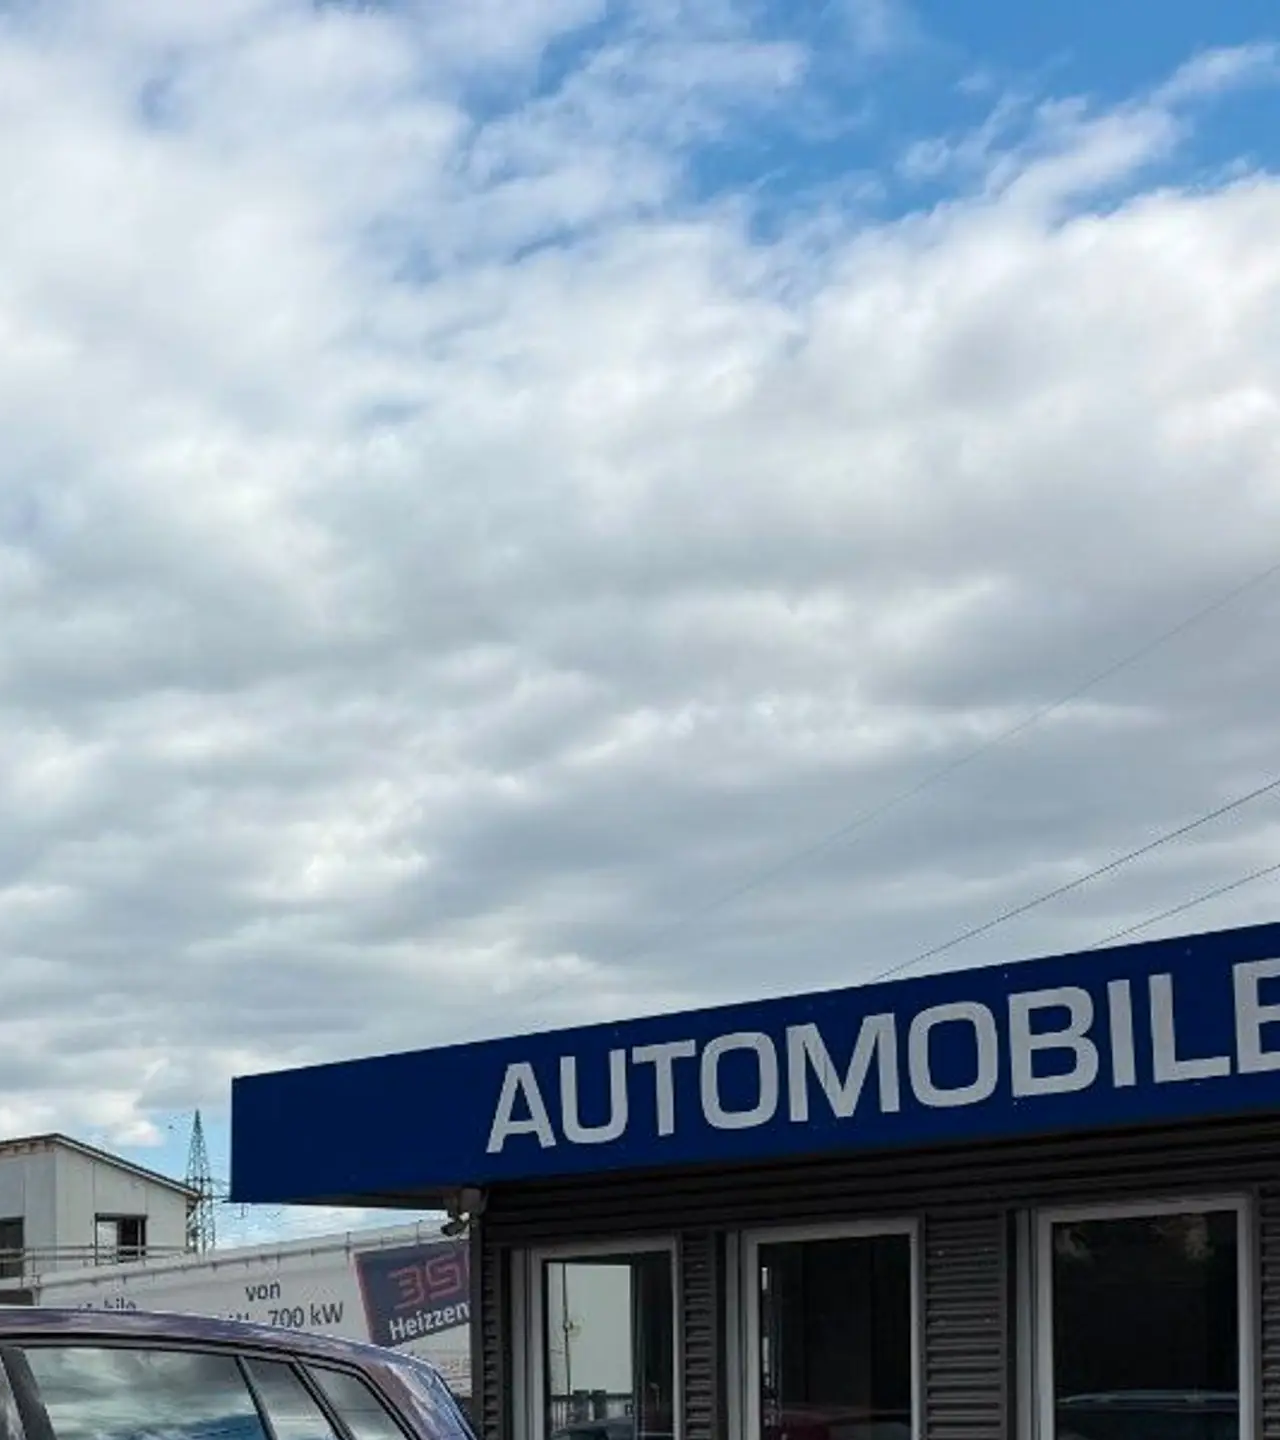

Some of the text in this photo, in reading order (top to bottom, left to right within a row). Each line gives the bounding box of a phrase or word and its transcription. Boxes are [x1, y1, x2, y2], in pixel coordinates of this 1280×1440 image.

[485, 956, 1280, 1154] AUTOMOBILE
[245, 1281, 281, 1302] von
[269, 1307, 305, 1328] 700
[311, 1302, 344, 1326] kW
